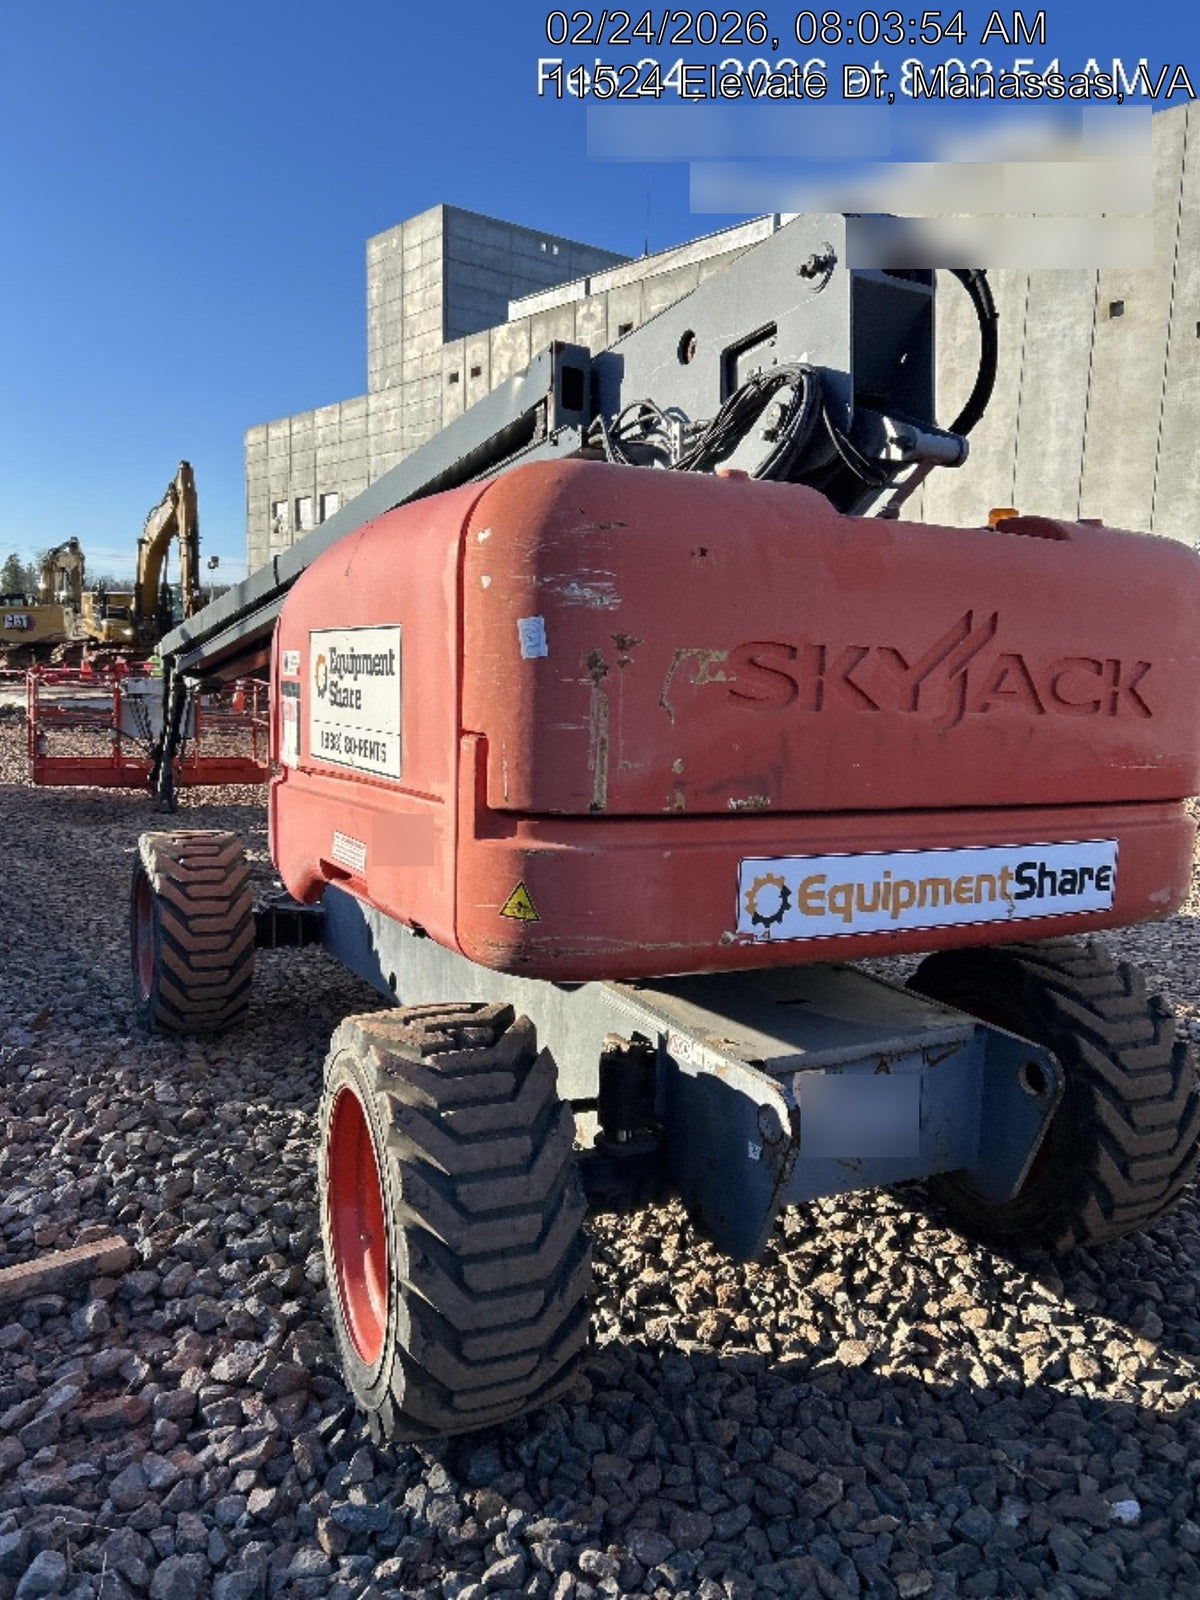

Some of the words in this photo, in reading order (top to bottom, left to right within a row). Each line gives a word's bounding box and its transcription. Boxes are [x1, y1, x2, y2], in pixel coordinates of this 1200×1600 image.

[329, 647, 395, 681] Equipment
[728, 609, 1152, 732] SKYJACK
[329, 680, 362, 710] Share
[798, 861, 1112, 924] EquipmentShare
